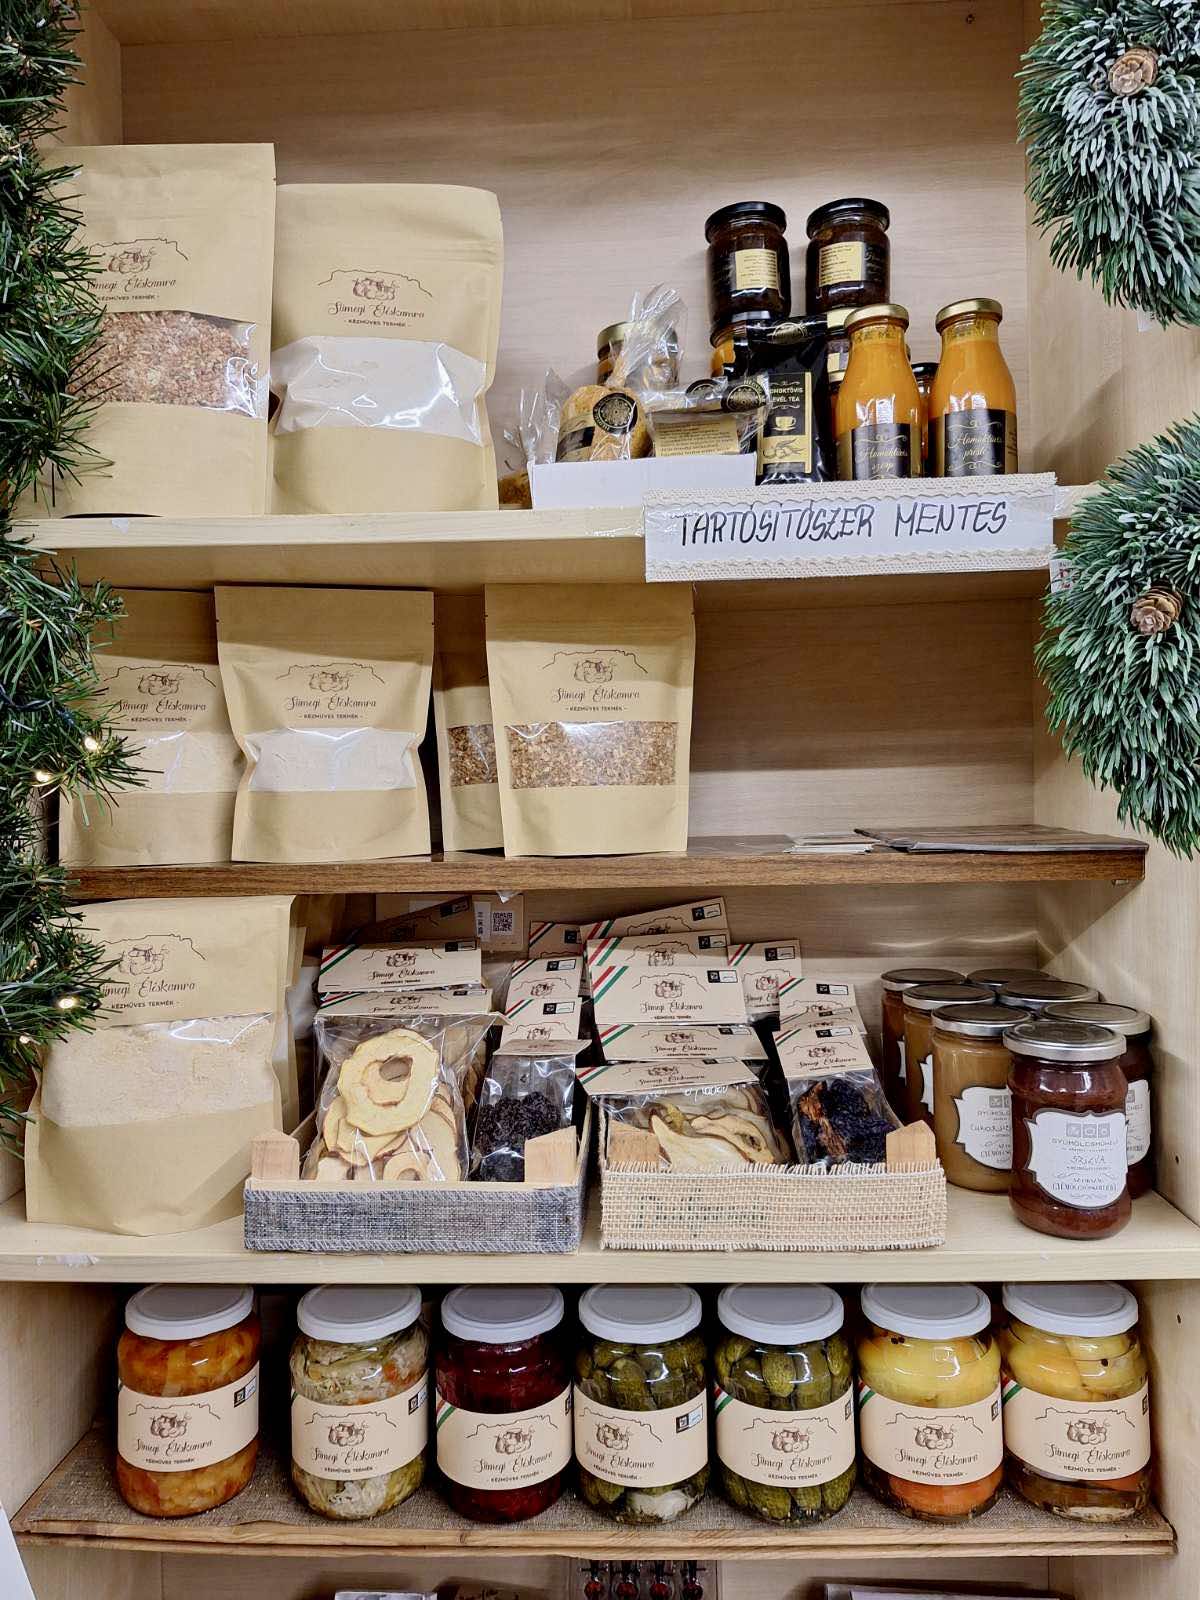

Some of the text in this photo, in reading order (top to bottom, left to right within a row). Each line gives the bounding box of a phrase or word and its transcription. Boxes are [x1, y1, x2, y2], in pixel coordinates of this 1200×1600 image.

[328, 301, 366, 316] Sümegi
[894, 500, 1007, 537] MENTES
[287, 695, 321, 711] Sümegi
[552, 687, 586, 703] Sümegi
[102, 976, 196, 998] ümegi Éléskamra
[135, 1438, 160, 1456] Sümegi
[312, 1447, 338, 1464] Sümegi
[1044, 1443, 1080, 1462] Sümegi
[473, 1458, 506, 1474] Sümegi
[751, 1453, 783, 1471] Sümegi
[895, 1448, 928, 1467] Sümegi
